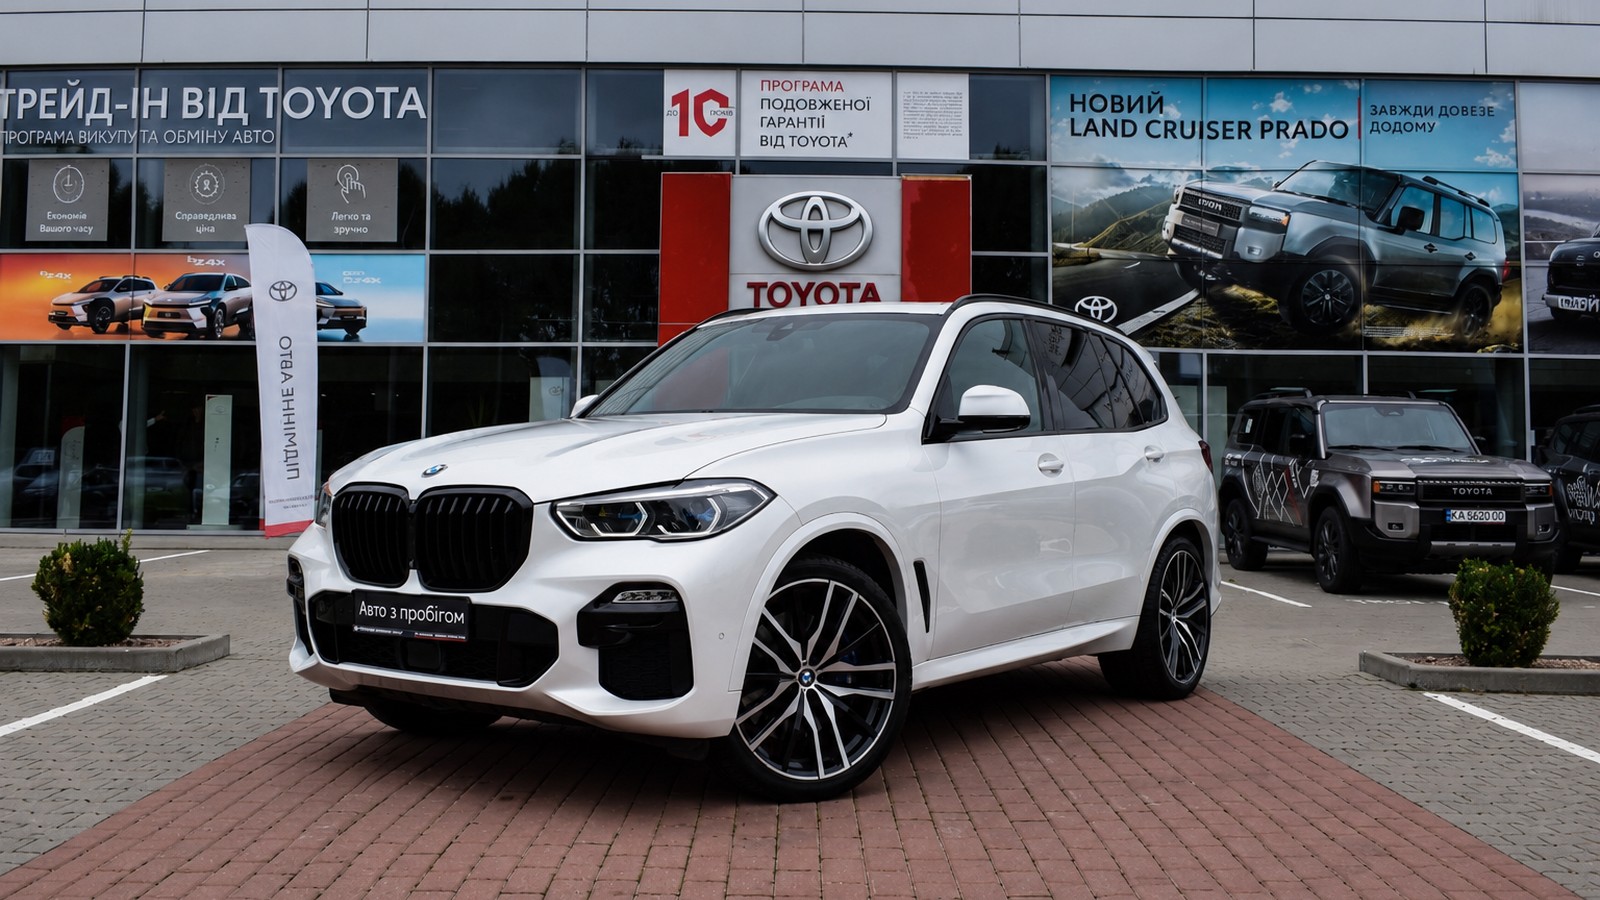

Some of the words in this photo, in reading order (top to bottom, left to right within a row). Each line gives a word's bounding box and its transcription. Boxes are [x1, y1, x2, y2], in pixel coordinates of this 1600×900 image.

[760, 79, 844, 92] ПРОГРАМА
[0, 79, 168, 126] ТРЕЙД-ІН
[182, 87, 249, 126] ВІД
[259, 86, 427, 119] TOYOTA
[760, 96, 871, 112] ПОДОВЖЕНОЇ
[1070, 91, 1164, 114] НОВИЙ
[1370, 104, 1434, 118] ЗАВЖДИ
[1438, 105, 1495, 118] ДОВЕЗЕ
[760, 115, 825, 128] ГАРАНТІЇ
[1370, 121, 1436, 134] ДОДОМУ
[1070, 118, 1137, 138] LAND
[1145, 119, 1252, 140] CRUISER
[1260, 120, 1349, 140] PRADO
[79, 130, 137, 144] ВИКУПУ
[140, 129, 158, 144] ТА
[163, 129, 228, 144] ОБМІНУ
[232, 130, 275, 144] АВТО
[760, 135, 785, 149] ВІД
[361, 213, 371, 221] та
[196, 224, 216, 234] ціна
[747, 281, 881, 308] TOYOTA
[1452, 487, 1493, 495] TOYOTA
[359, 600, 387, 618] Авто
[390, 607, 397, 619] з
[400, 605, 465, 625] пробігом
